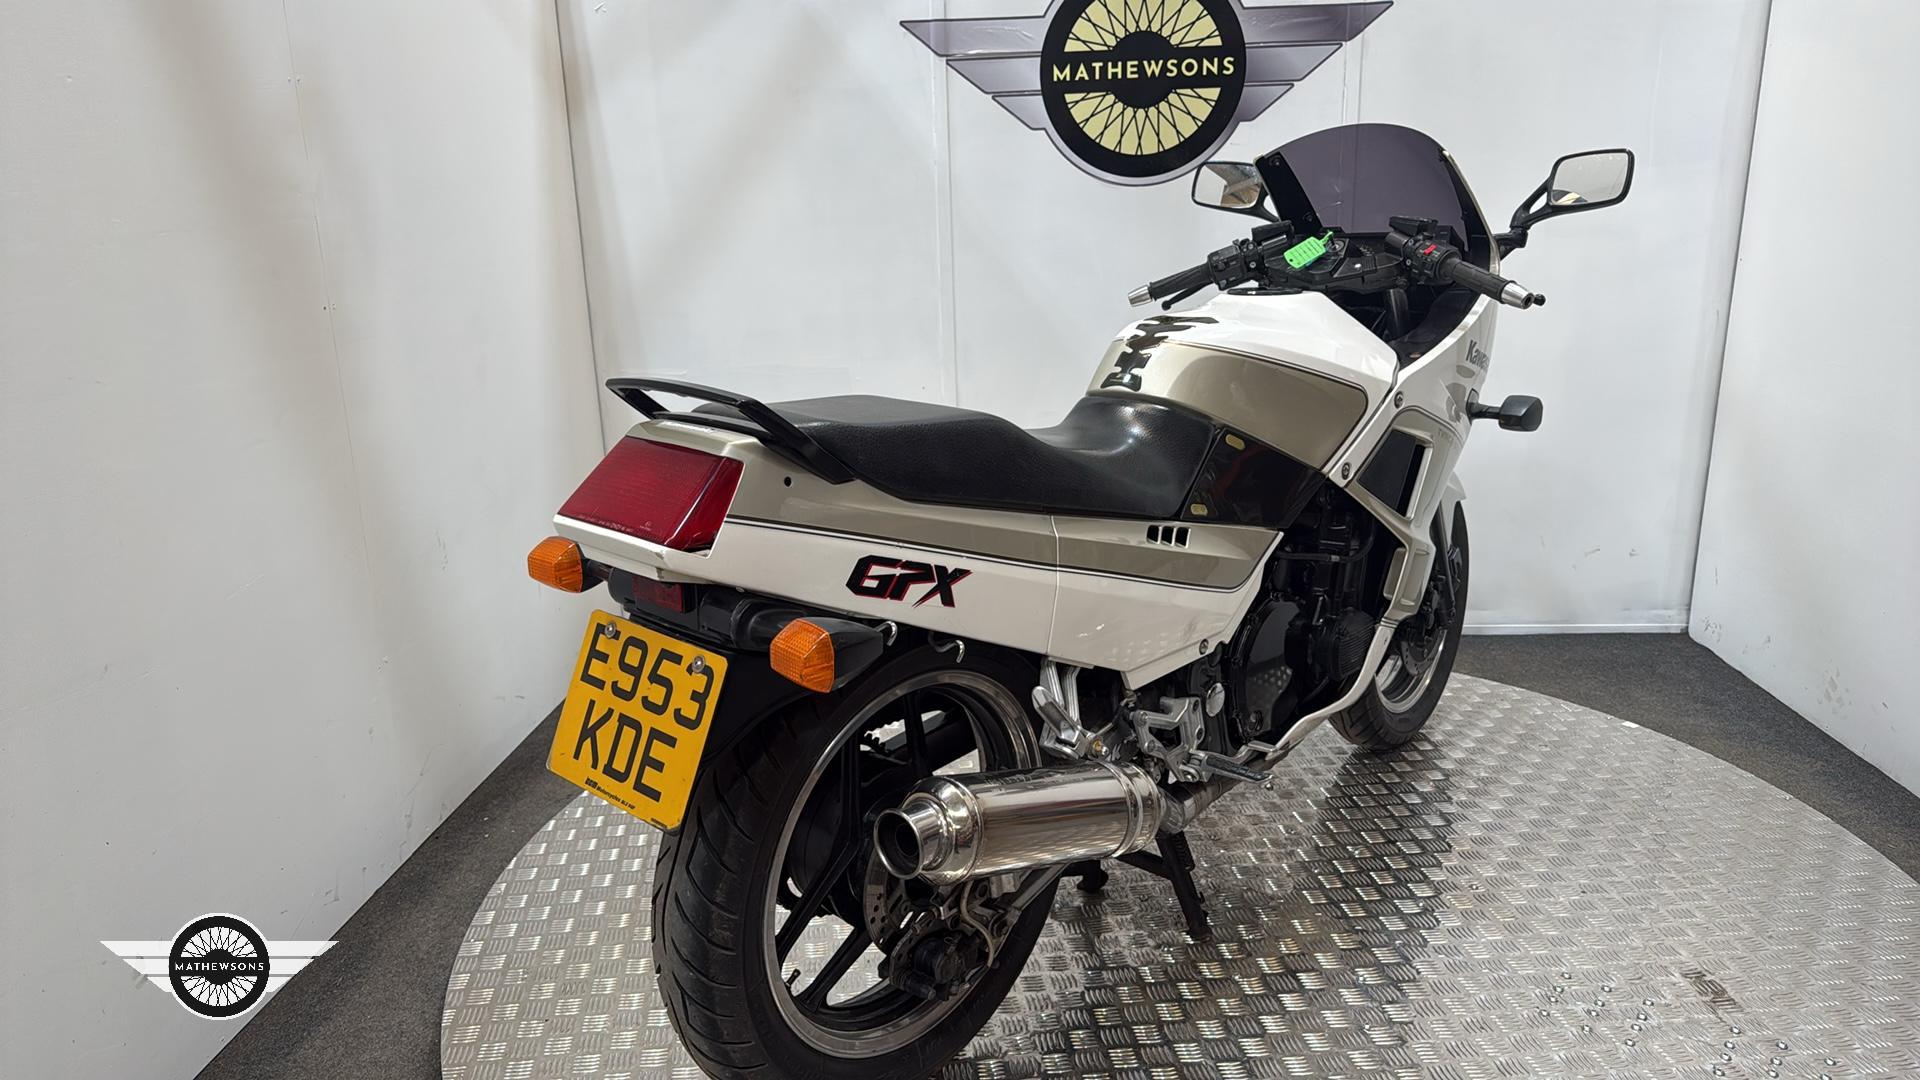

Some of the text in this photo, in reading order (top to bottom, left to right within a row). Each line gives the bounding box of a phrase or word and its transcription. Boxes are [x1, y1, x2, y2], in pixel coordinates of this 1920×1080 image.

[1052, 57, 1235, 82] MATHEWSONS
[845, 554, 973, 608] GPX
[580, 622, 715, 731] E953
[573, 698, 678, 803] KDE
